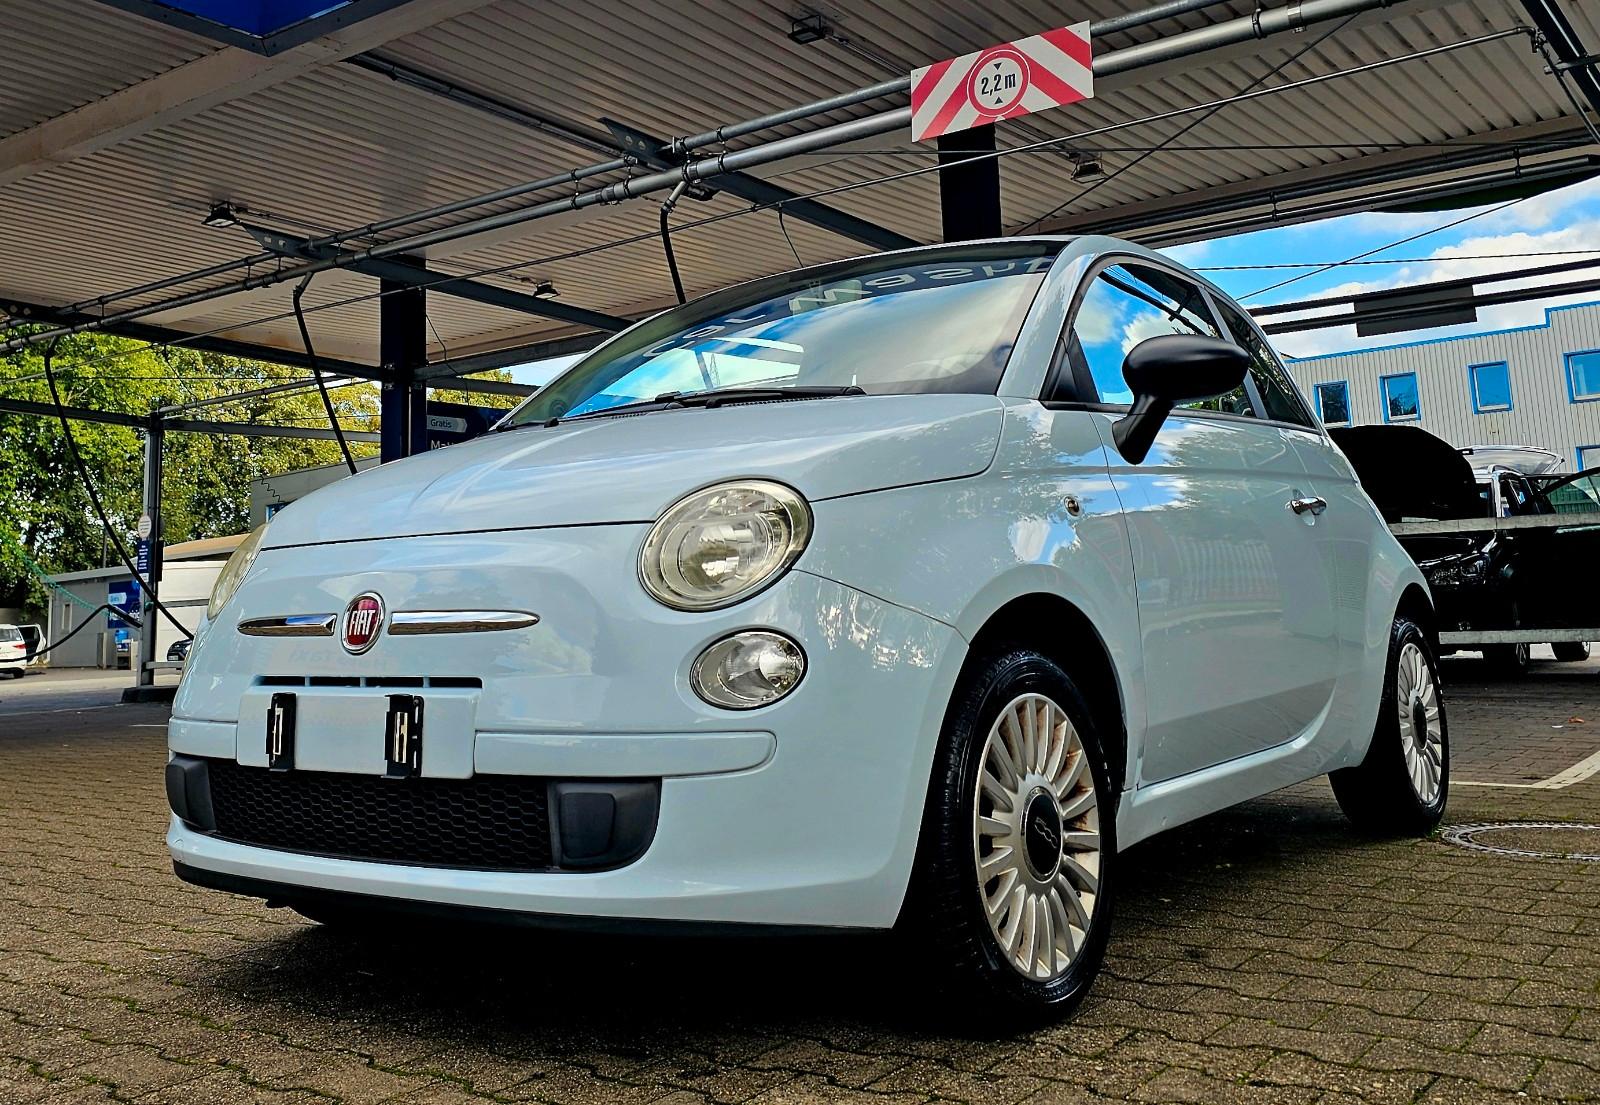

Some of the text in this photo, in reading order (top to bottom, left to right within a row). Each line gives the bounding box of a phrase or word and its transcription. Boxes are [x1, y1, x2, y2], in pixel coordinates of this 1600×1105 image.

[981, 73, 1017, 97] 2,2 m
[430, 418, 452, 428] Gratis
[348, 609, 376, 636] FIAT
